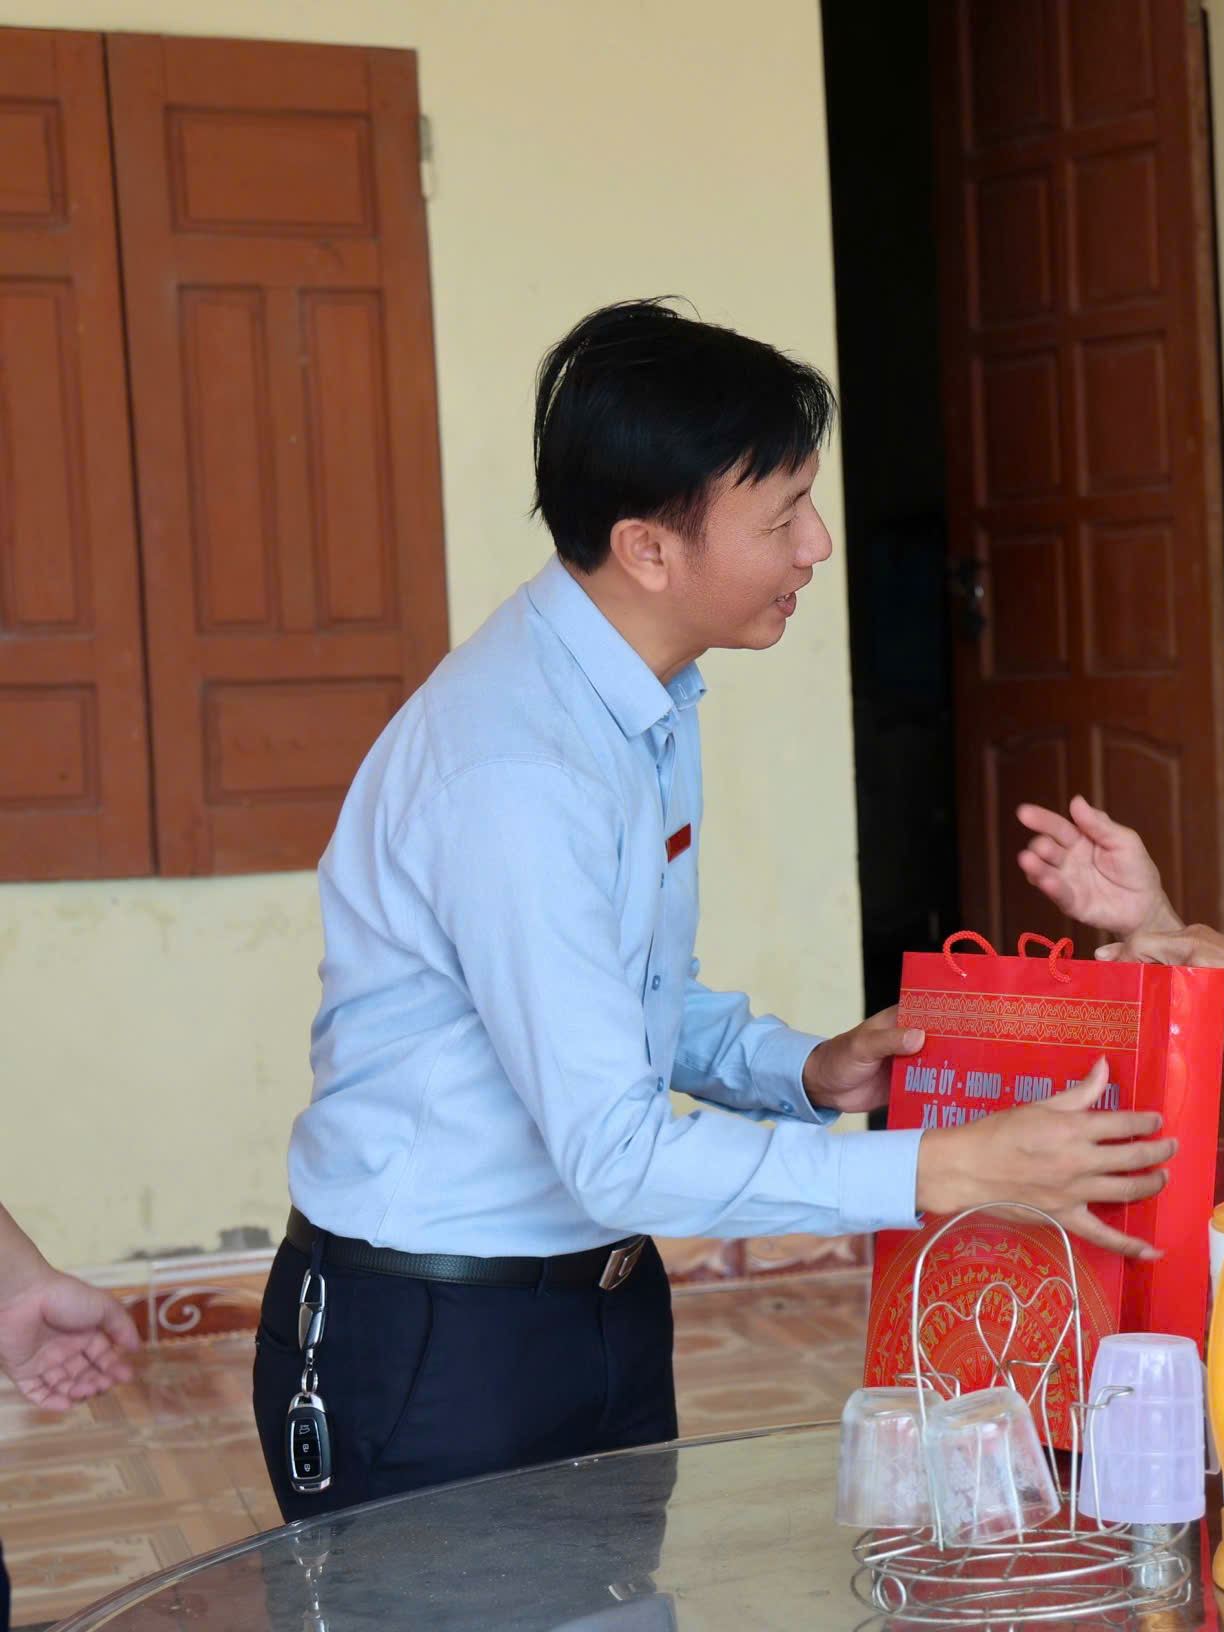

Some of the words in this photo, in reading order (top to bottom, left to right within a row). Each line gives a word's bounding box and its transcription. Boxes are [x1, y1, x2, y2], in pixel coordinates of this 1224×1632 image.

[905, 1058, 937, 1093] ĐẢNG
[939, 1060, 955, 1095] ỦY
[966, 1071, 1001, 1099] HĐND
[1015, 1075, 1051, 1102] UBND
[921, 1100, 937, 1129] XÃ
